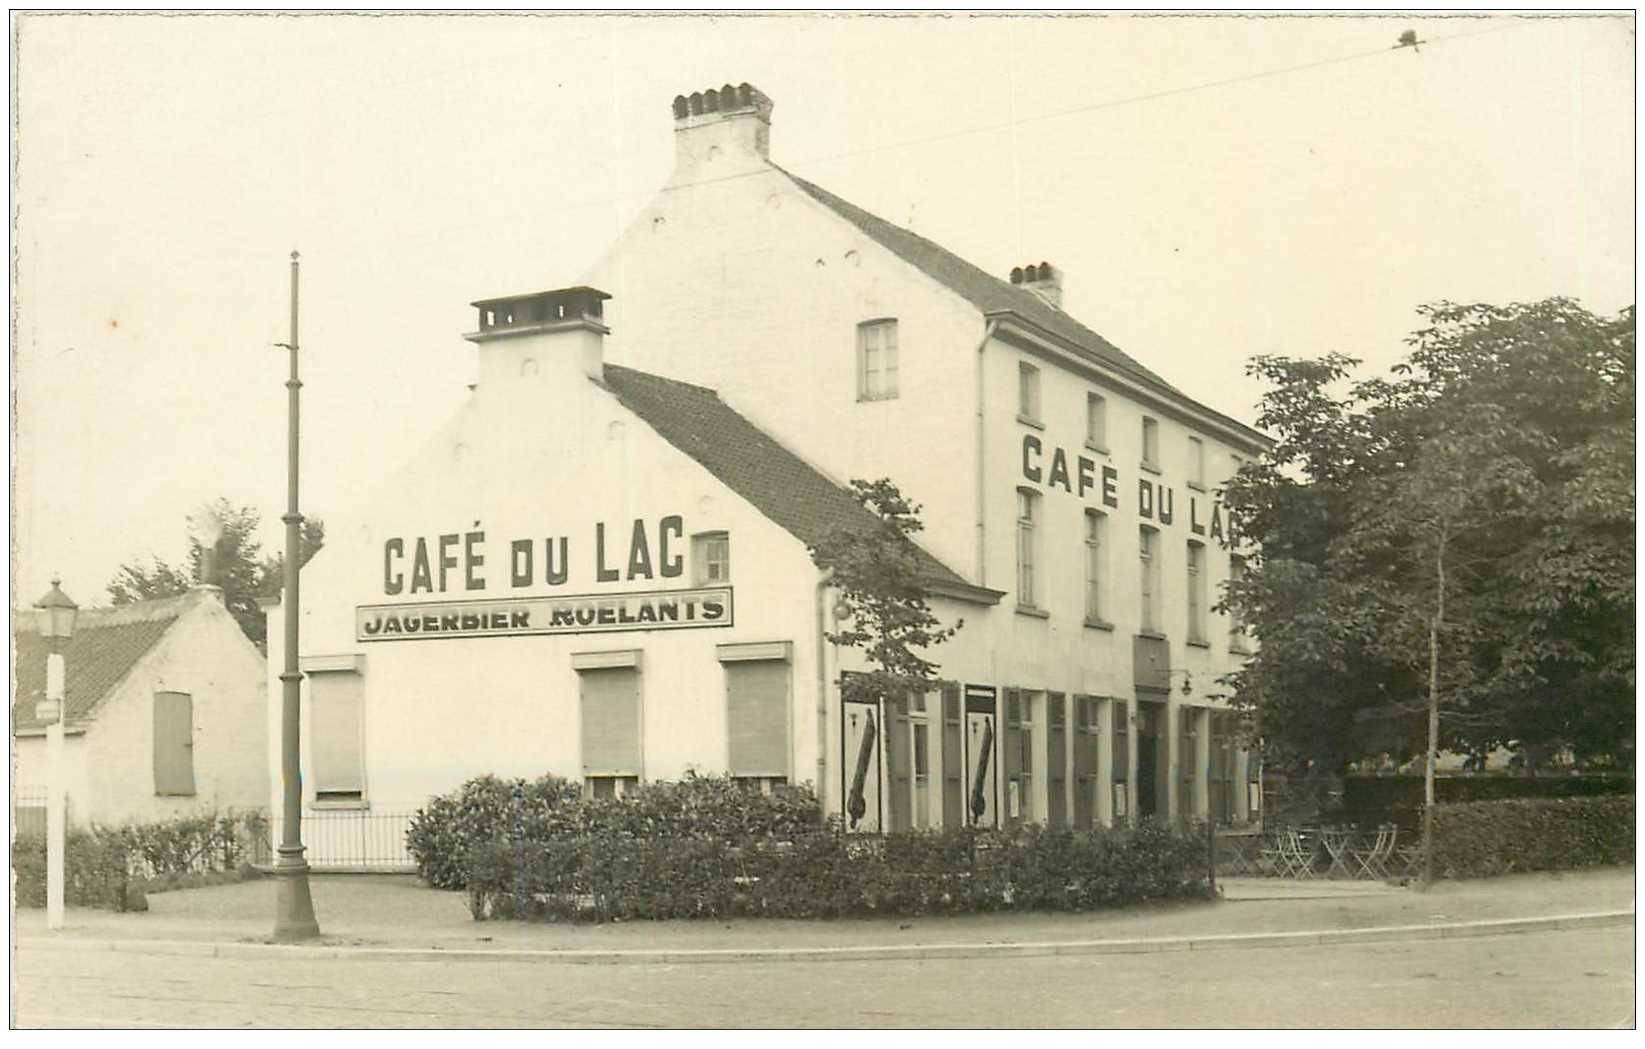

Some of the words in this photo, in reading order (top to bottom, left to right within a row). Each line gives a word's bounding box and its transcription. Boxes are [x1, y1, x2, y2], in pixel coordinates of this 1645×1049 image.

[1139, 479, 1173, 525] DU
[384, 521, 485, 595] CAFÉ
[511, 537, 568, 588] DU
[597, 515, 683, 583] LAC
[549, 596, 724, 627] ROELANTS
